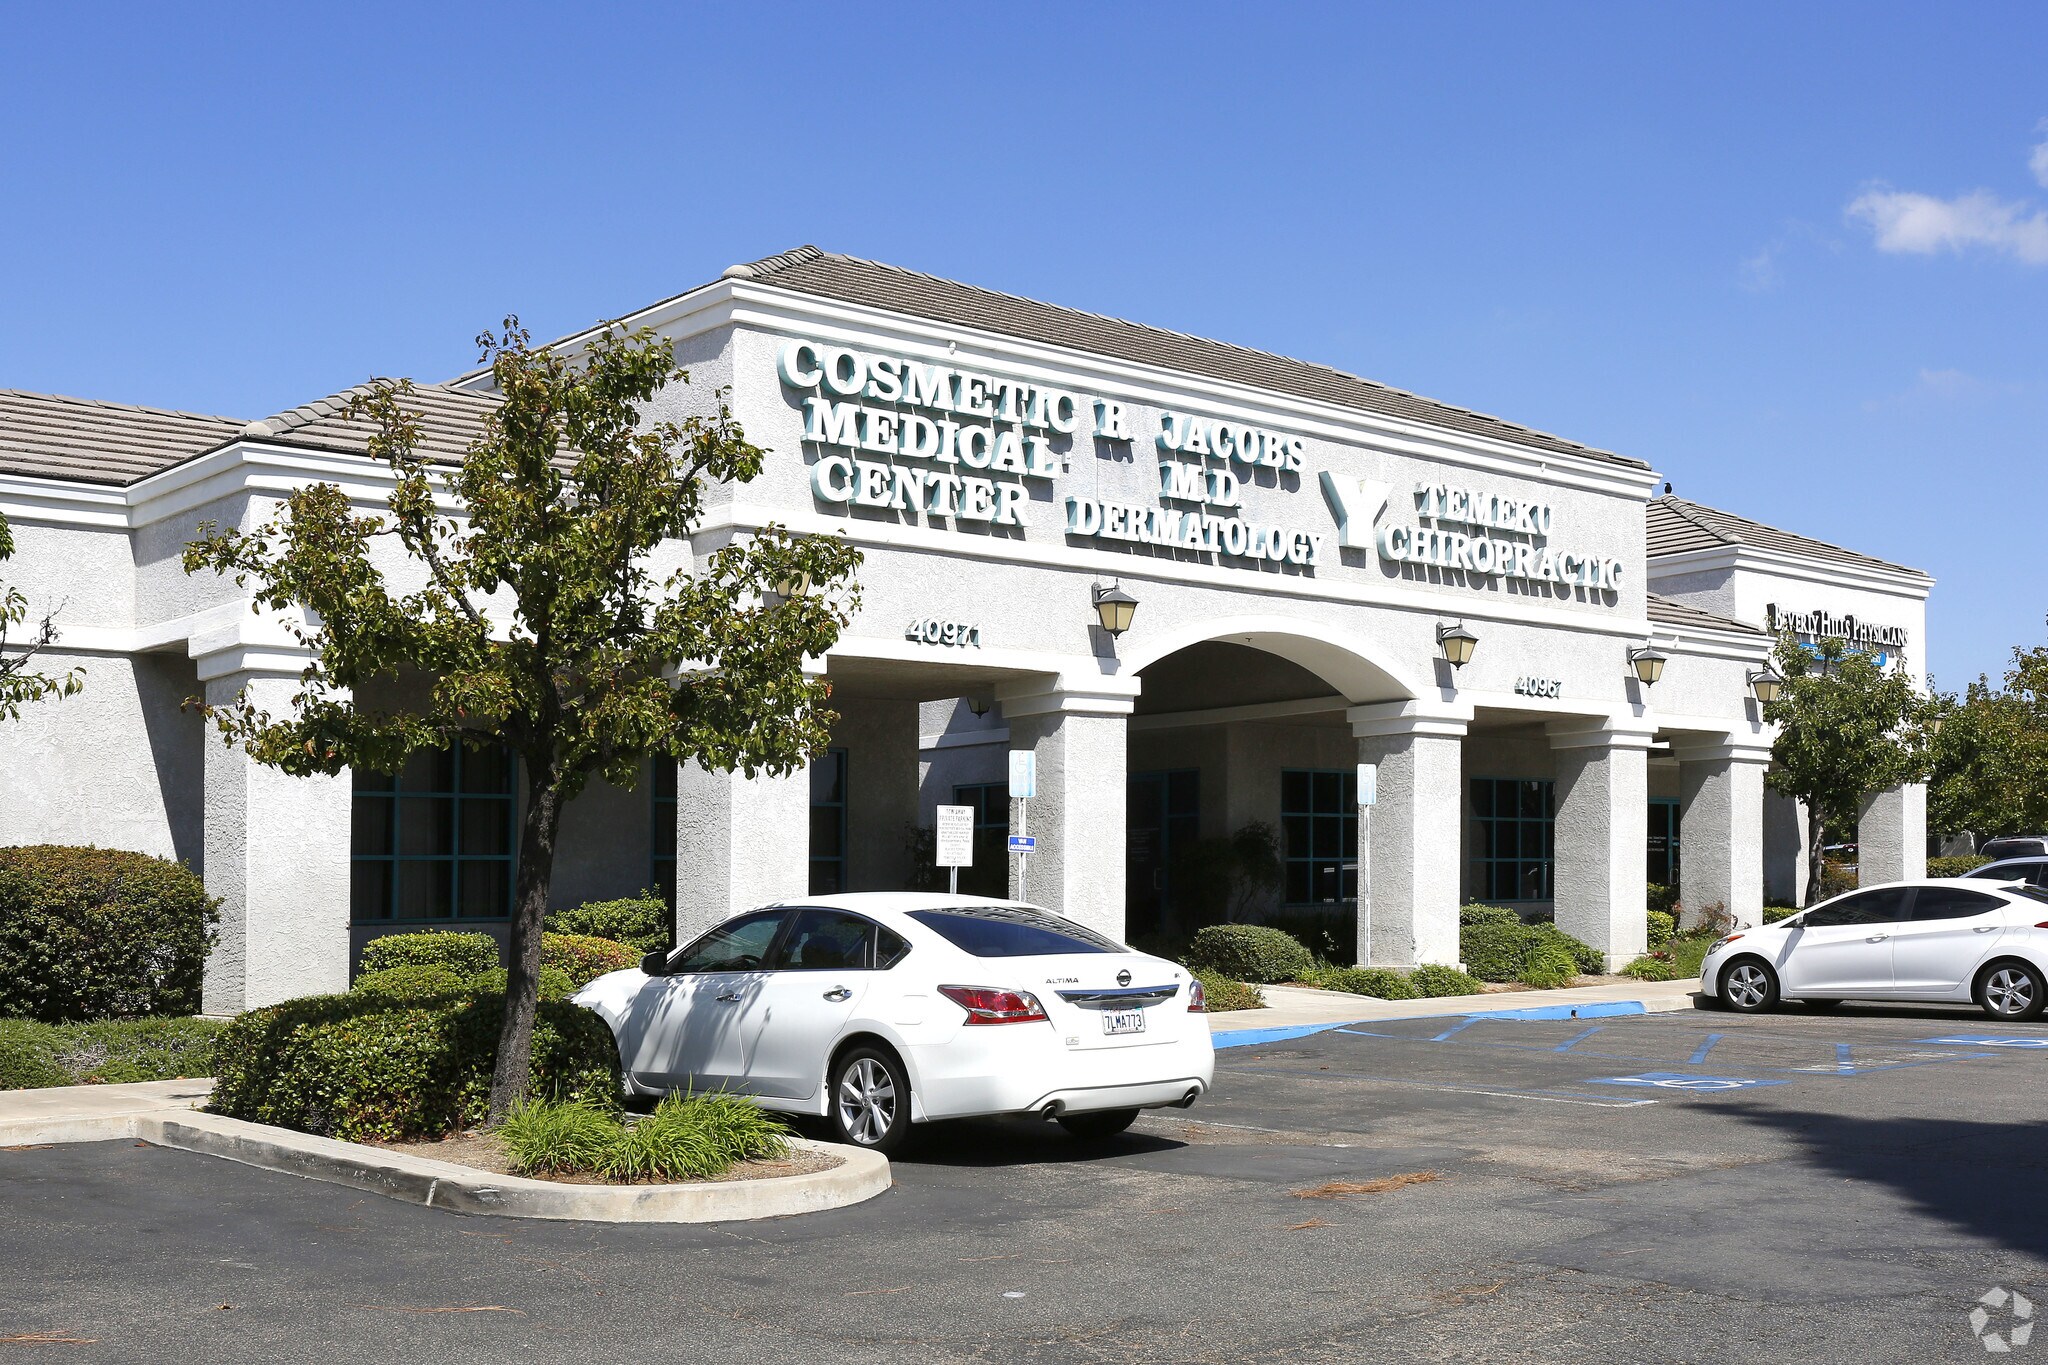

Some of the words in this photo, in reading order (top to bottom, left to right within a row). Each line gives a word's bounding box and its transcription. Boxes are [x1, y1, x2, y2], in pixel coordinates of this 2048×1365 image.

[777, 339, 1081, 434] COSMETIC
[801, 397, 1059, 480] MEDICAL
[1155, 412, 1308, 473] JACOBS
[810, 455, 1034, 527] CENTER
[1414, 481, 1551, 537] TEMEKU
[1065, 496, 1327, 566] DERMATOLOGY
[1377, 523, 1626, 592] CHIROPRACTIC
[1104, 1013, 1143, 1029] 7LMA773
